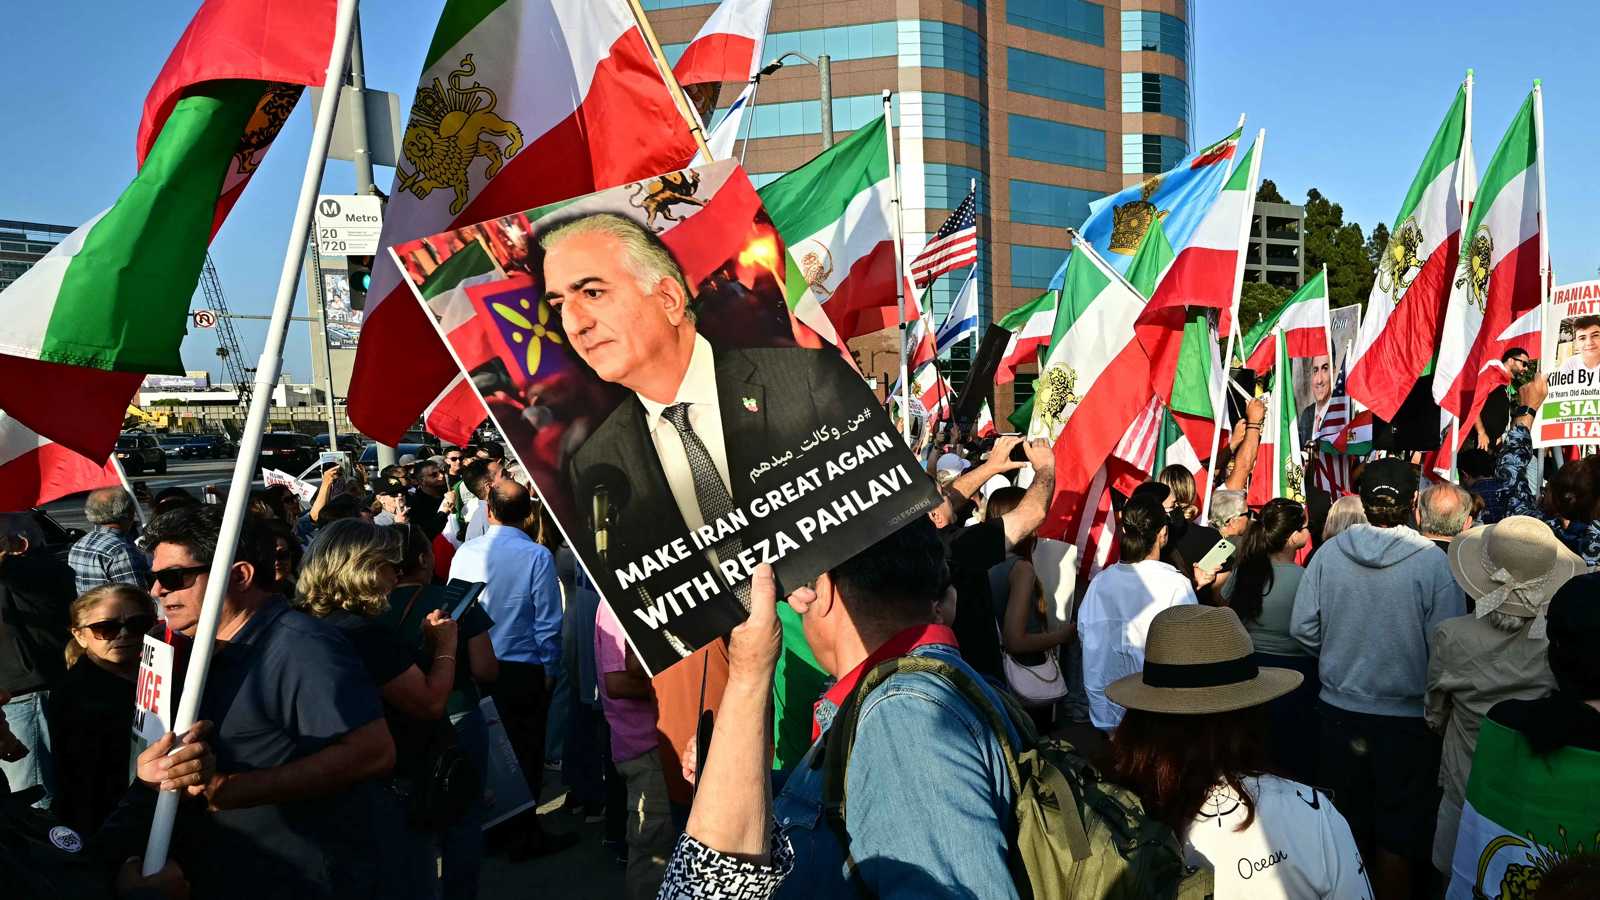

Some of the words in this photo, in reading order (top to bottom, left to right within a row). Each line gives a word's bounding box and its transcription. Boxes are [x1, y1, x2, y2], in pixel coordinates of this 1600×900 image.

[320, 200, 340, 216] M
[345, 213, 378, 222] Metro
[321, 229, 338, 239] 20
[322, 241, 347, 251] 720
[1547, 369, 1574, 387] Killed
[1578, 368, 1594, 387] By
[1569, 389, 1580, 397] Old
[1559, 400, 1600, 417] STA
[614, 537, 692, 591] MAKE
[690, 509, 749, 550] IRAN
[750, 467, 823, 518] GREAT
[826, 431, 894, 481] AGAIN
[633, 570, 721, 630] WITH
[720, 530, 800, 586] REZA
[795, 463, 913, 543] PAHLAVI
[1237, 850, 1288, 880] Ocean
